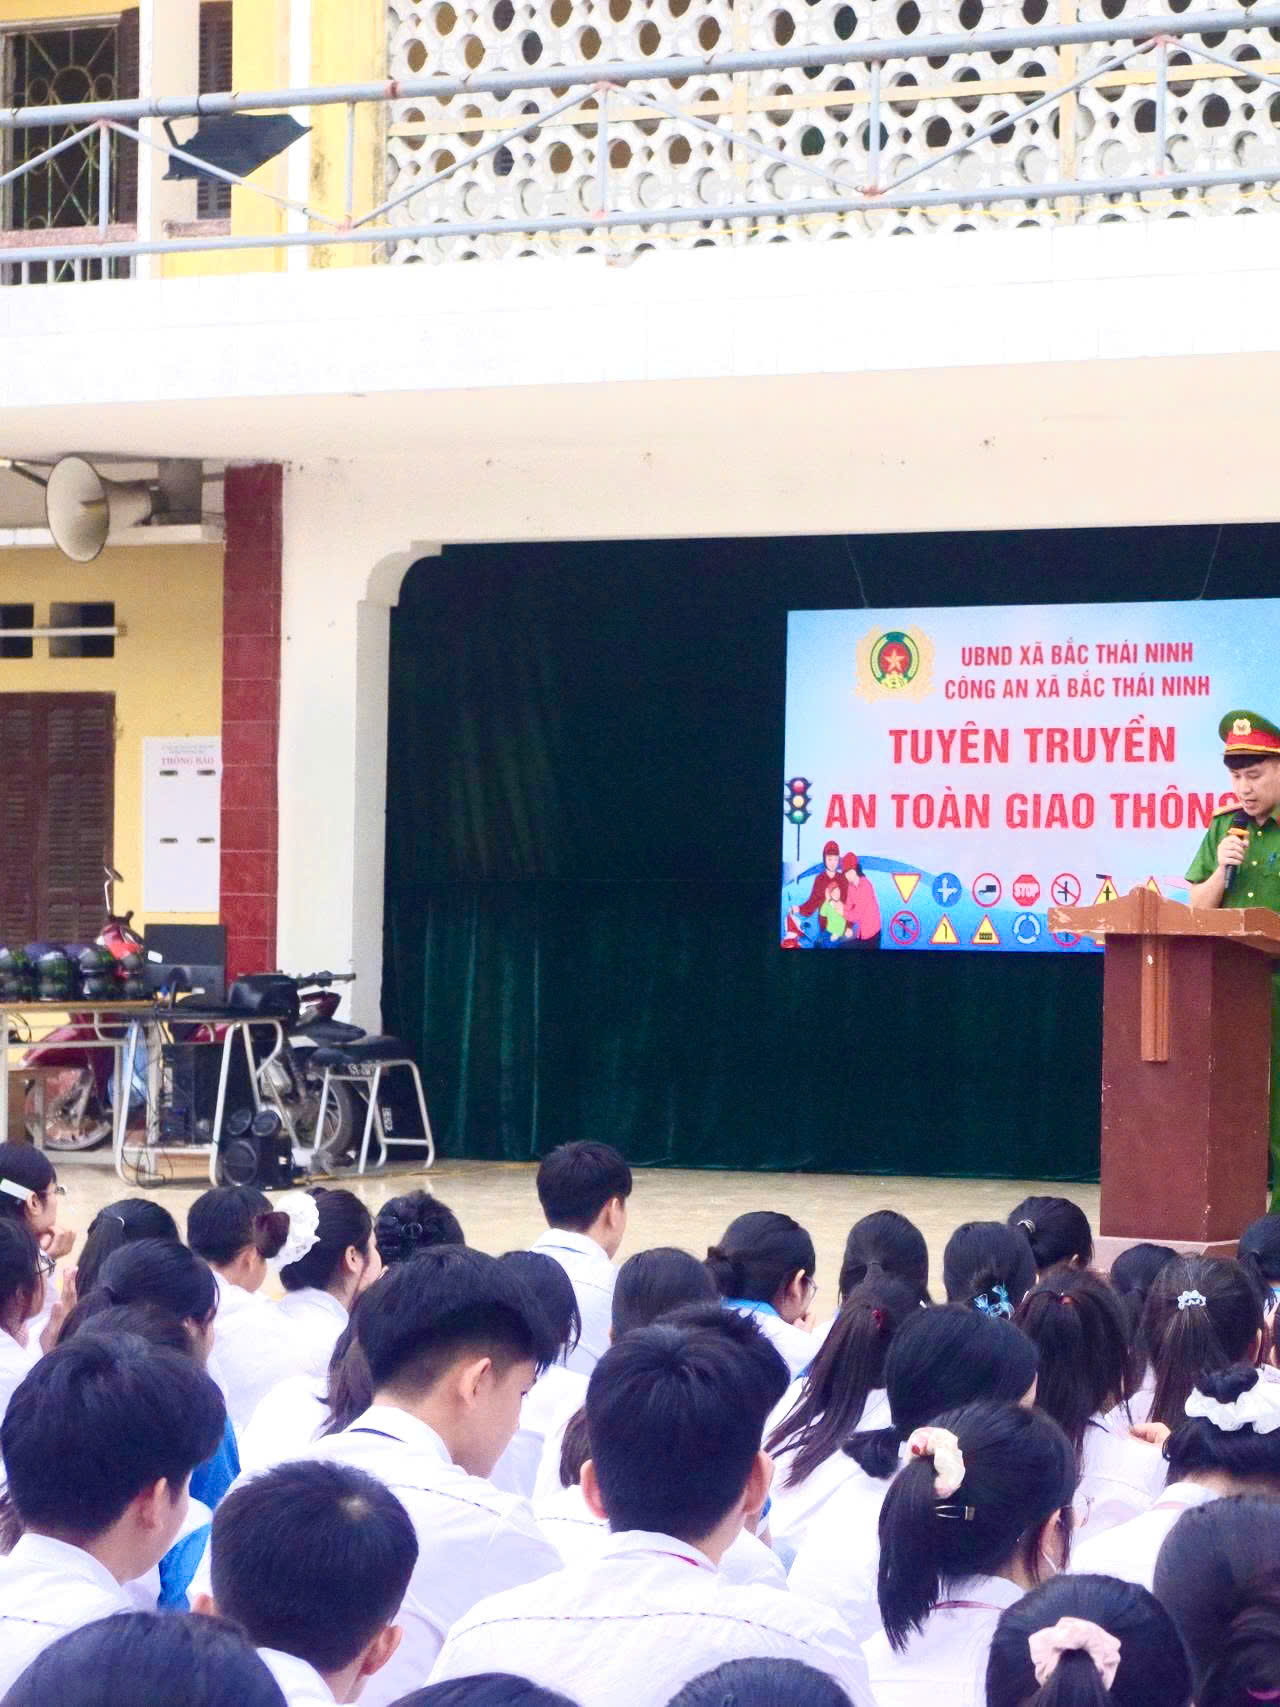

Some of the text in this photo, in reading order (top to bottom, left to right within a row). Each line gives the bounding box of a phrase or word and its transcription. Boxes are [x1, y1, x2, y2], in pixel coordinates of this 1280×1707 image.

[961, 637, 1193, 666] UBND XÃ BẮC THÁI NINH
[945, 670, 1210, 699] CÔNG AN XÃ BẮC THÁI NINH
[888, 714, 1176, 765] TUYÊN TRUYỀN
[825, 794, 877, 829] AN
[891, 786, 990, 829] TOÀN
[1006, 792, 1095, 829] GIAO
